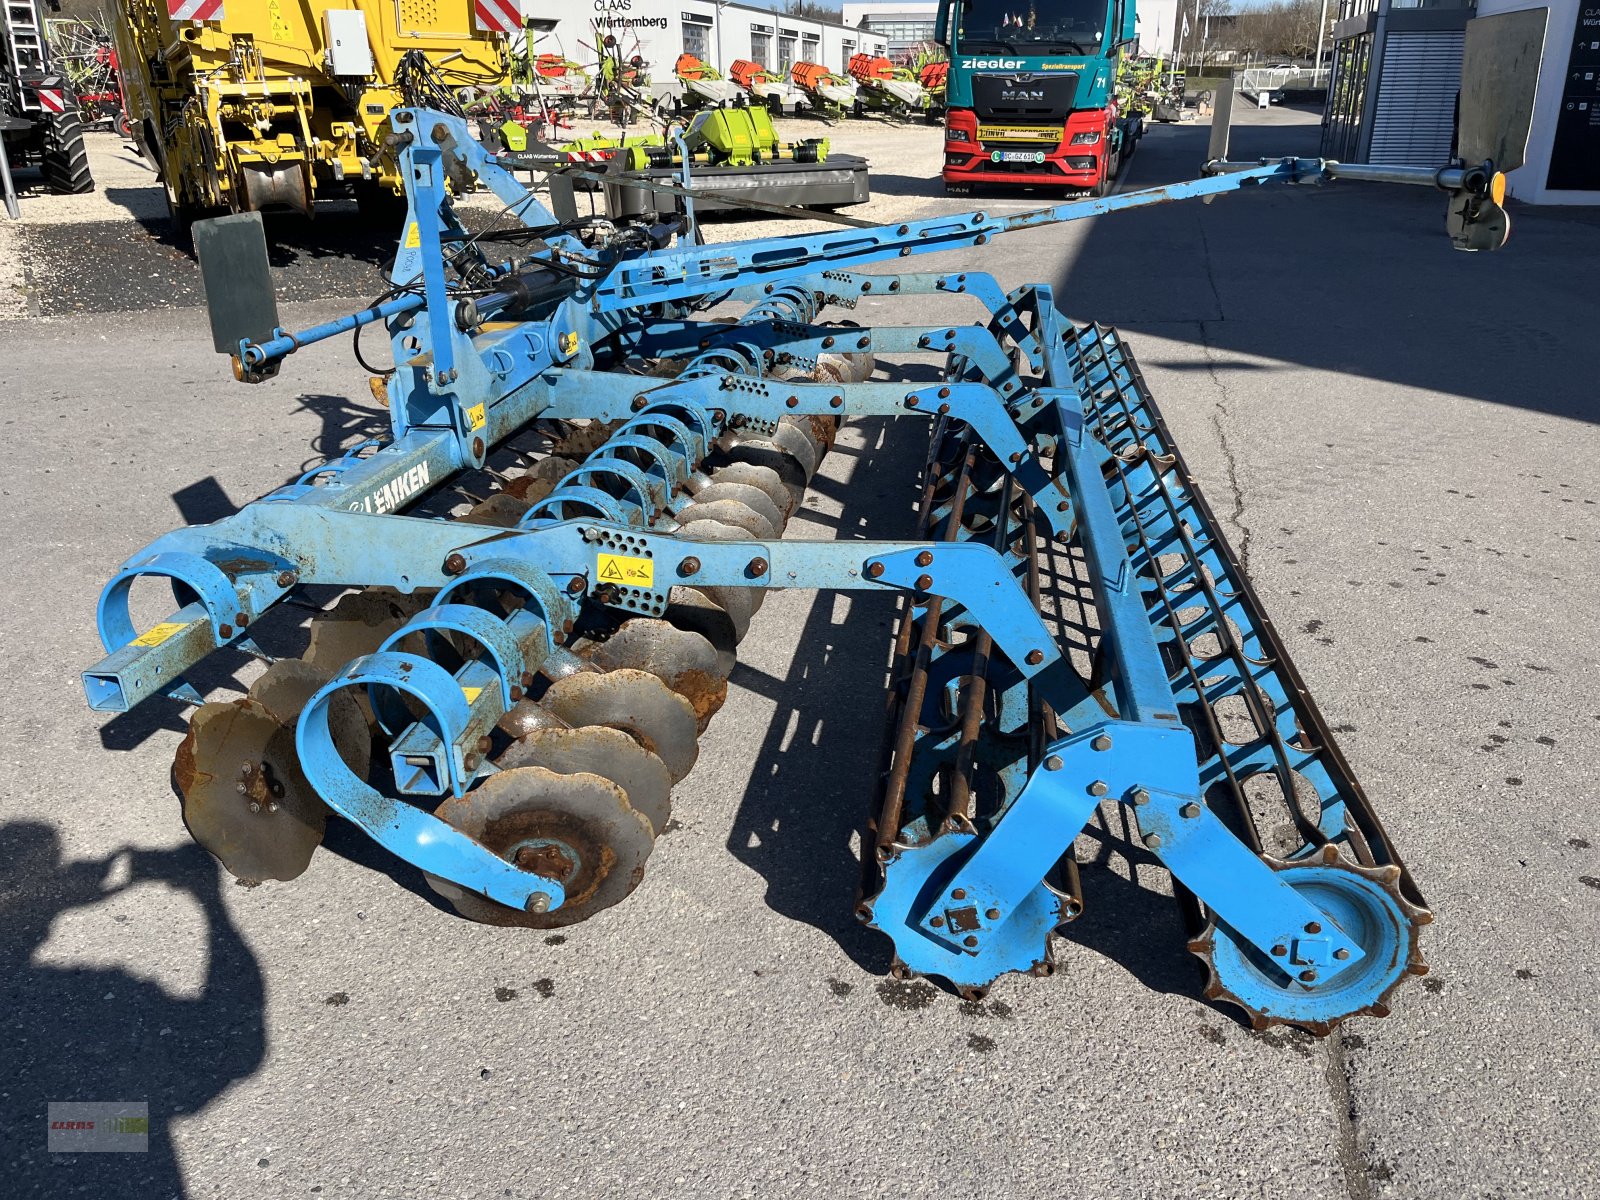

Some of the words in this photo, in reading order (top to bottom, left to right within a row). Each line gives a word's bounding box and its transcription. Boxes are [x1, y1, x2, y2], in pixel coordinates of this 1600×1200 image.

[594, 0, 632, 11] CLAAS
[595, 16, 667, 29] Württemberg
[1096, 77, 1106, 89] 71
[1001, 90, 1044, 101] MAN
